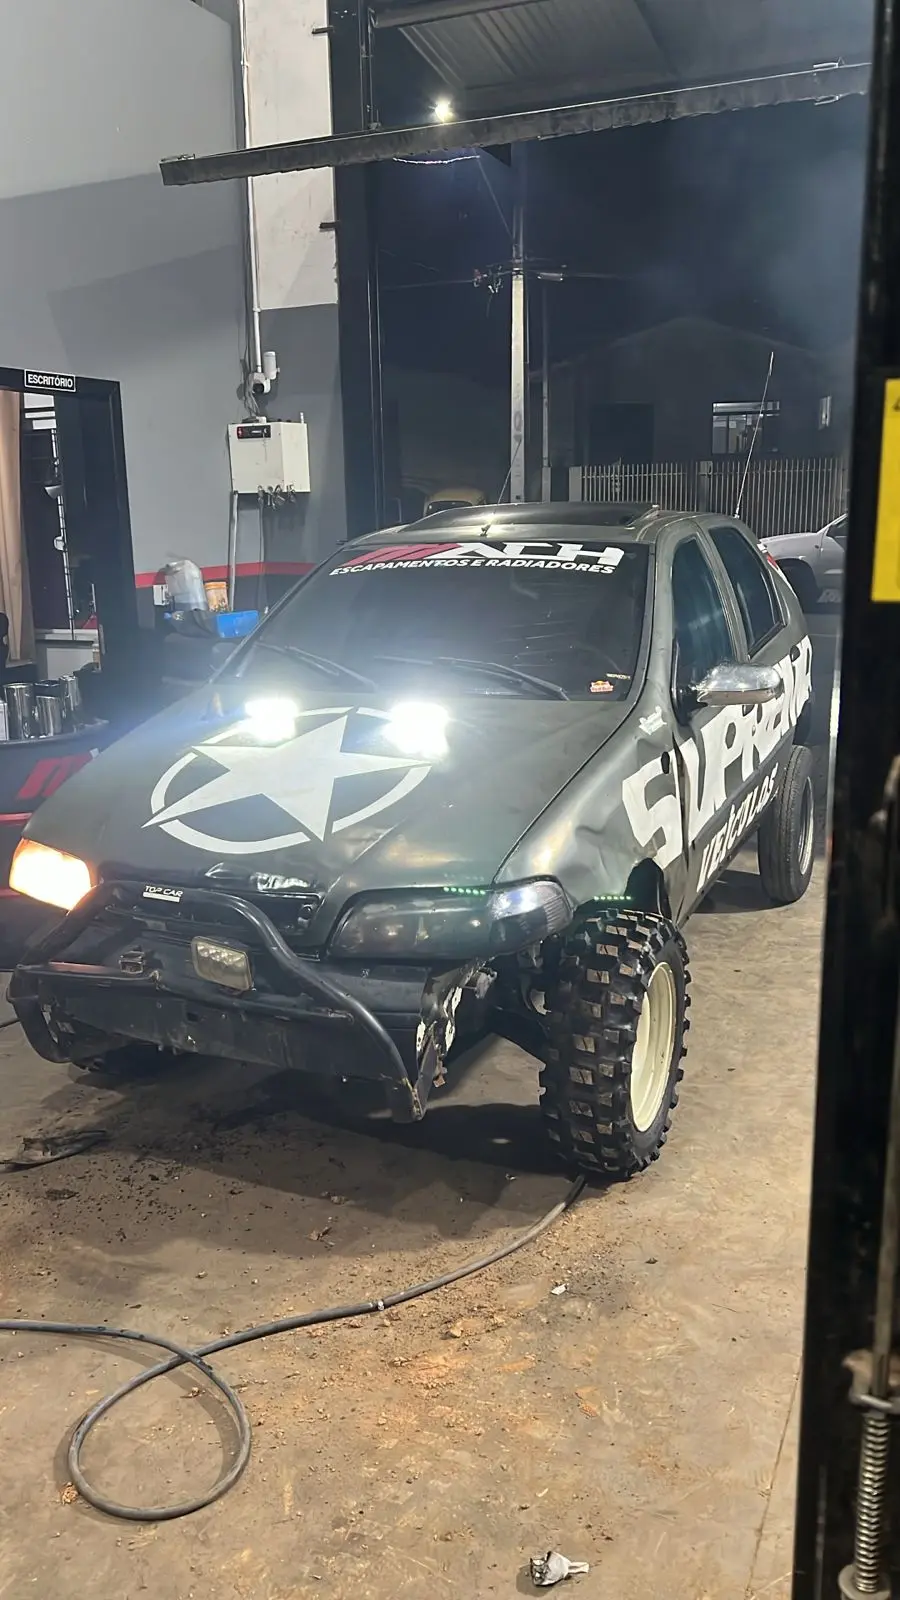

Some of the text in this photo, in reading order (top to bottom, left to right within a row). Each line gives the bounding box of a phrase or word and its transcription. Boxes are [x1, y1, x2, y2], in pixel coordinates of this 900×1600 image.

[27, 373, 73, 388] ESCRITÓRIO
[328, 558, 616, 576] ESCAPAMENTOS E RADIADORES
[145, 885, 184, 897] TOP CAR
